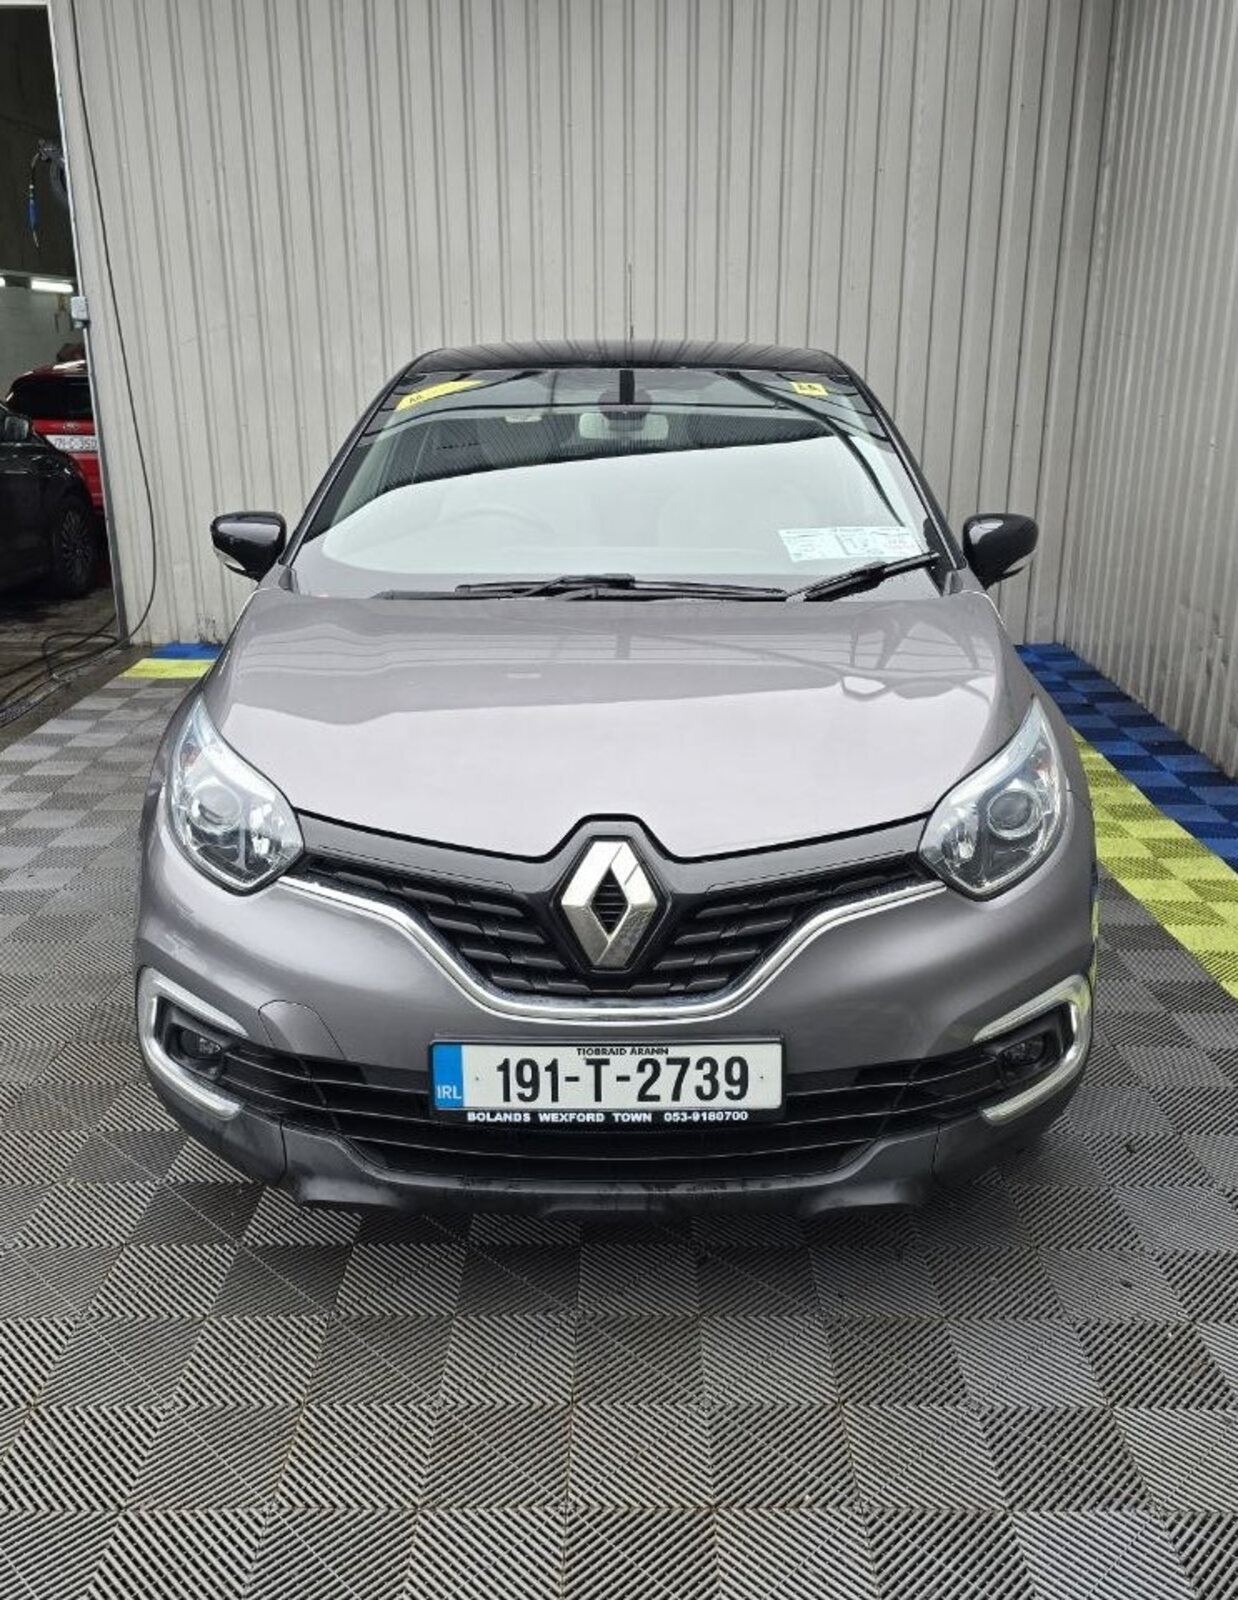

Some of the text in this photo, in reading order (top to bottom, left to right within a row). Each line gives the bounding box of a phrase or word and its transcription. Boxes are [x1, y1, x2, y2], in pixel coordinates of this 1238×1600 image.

[576, 1047, 627, 1056] TIOBRAID
[496, 1056, 749, 1103] 191-T-2739
[436, 1085, 462, 1100] IRL
[467, 1111, 749, 1123] BOLANDS WEXFORD TOWN 053-9180700
